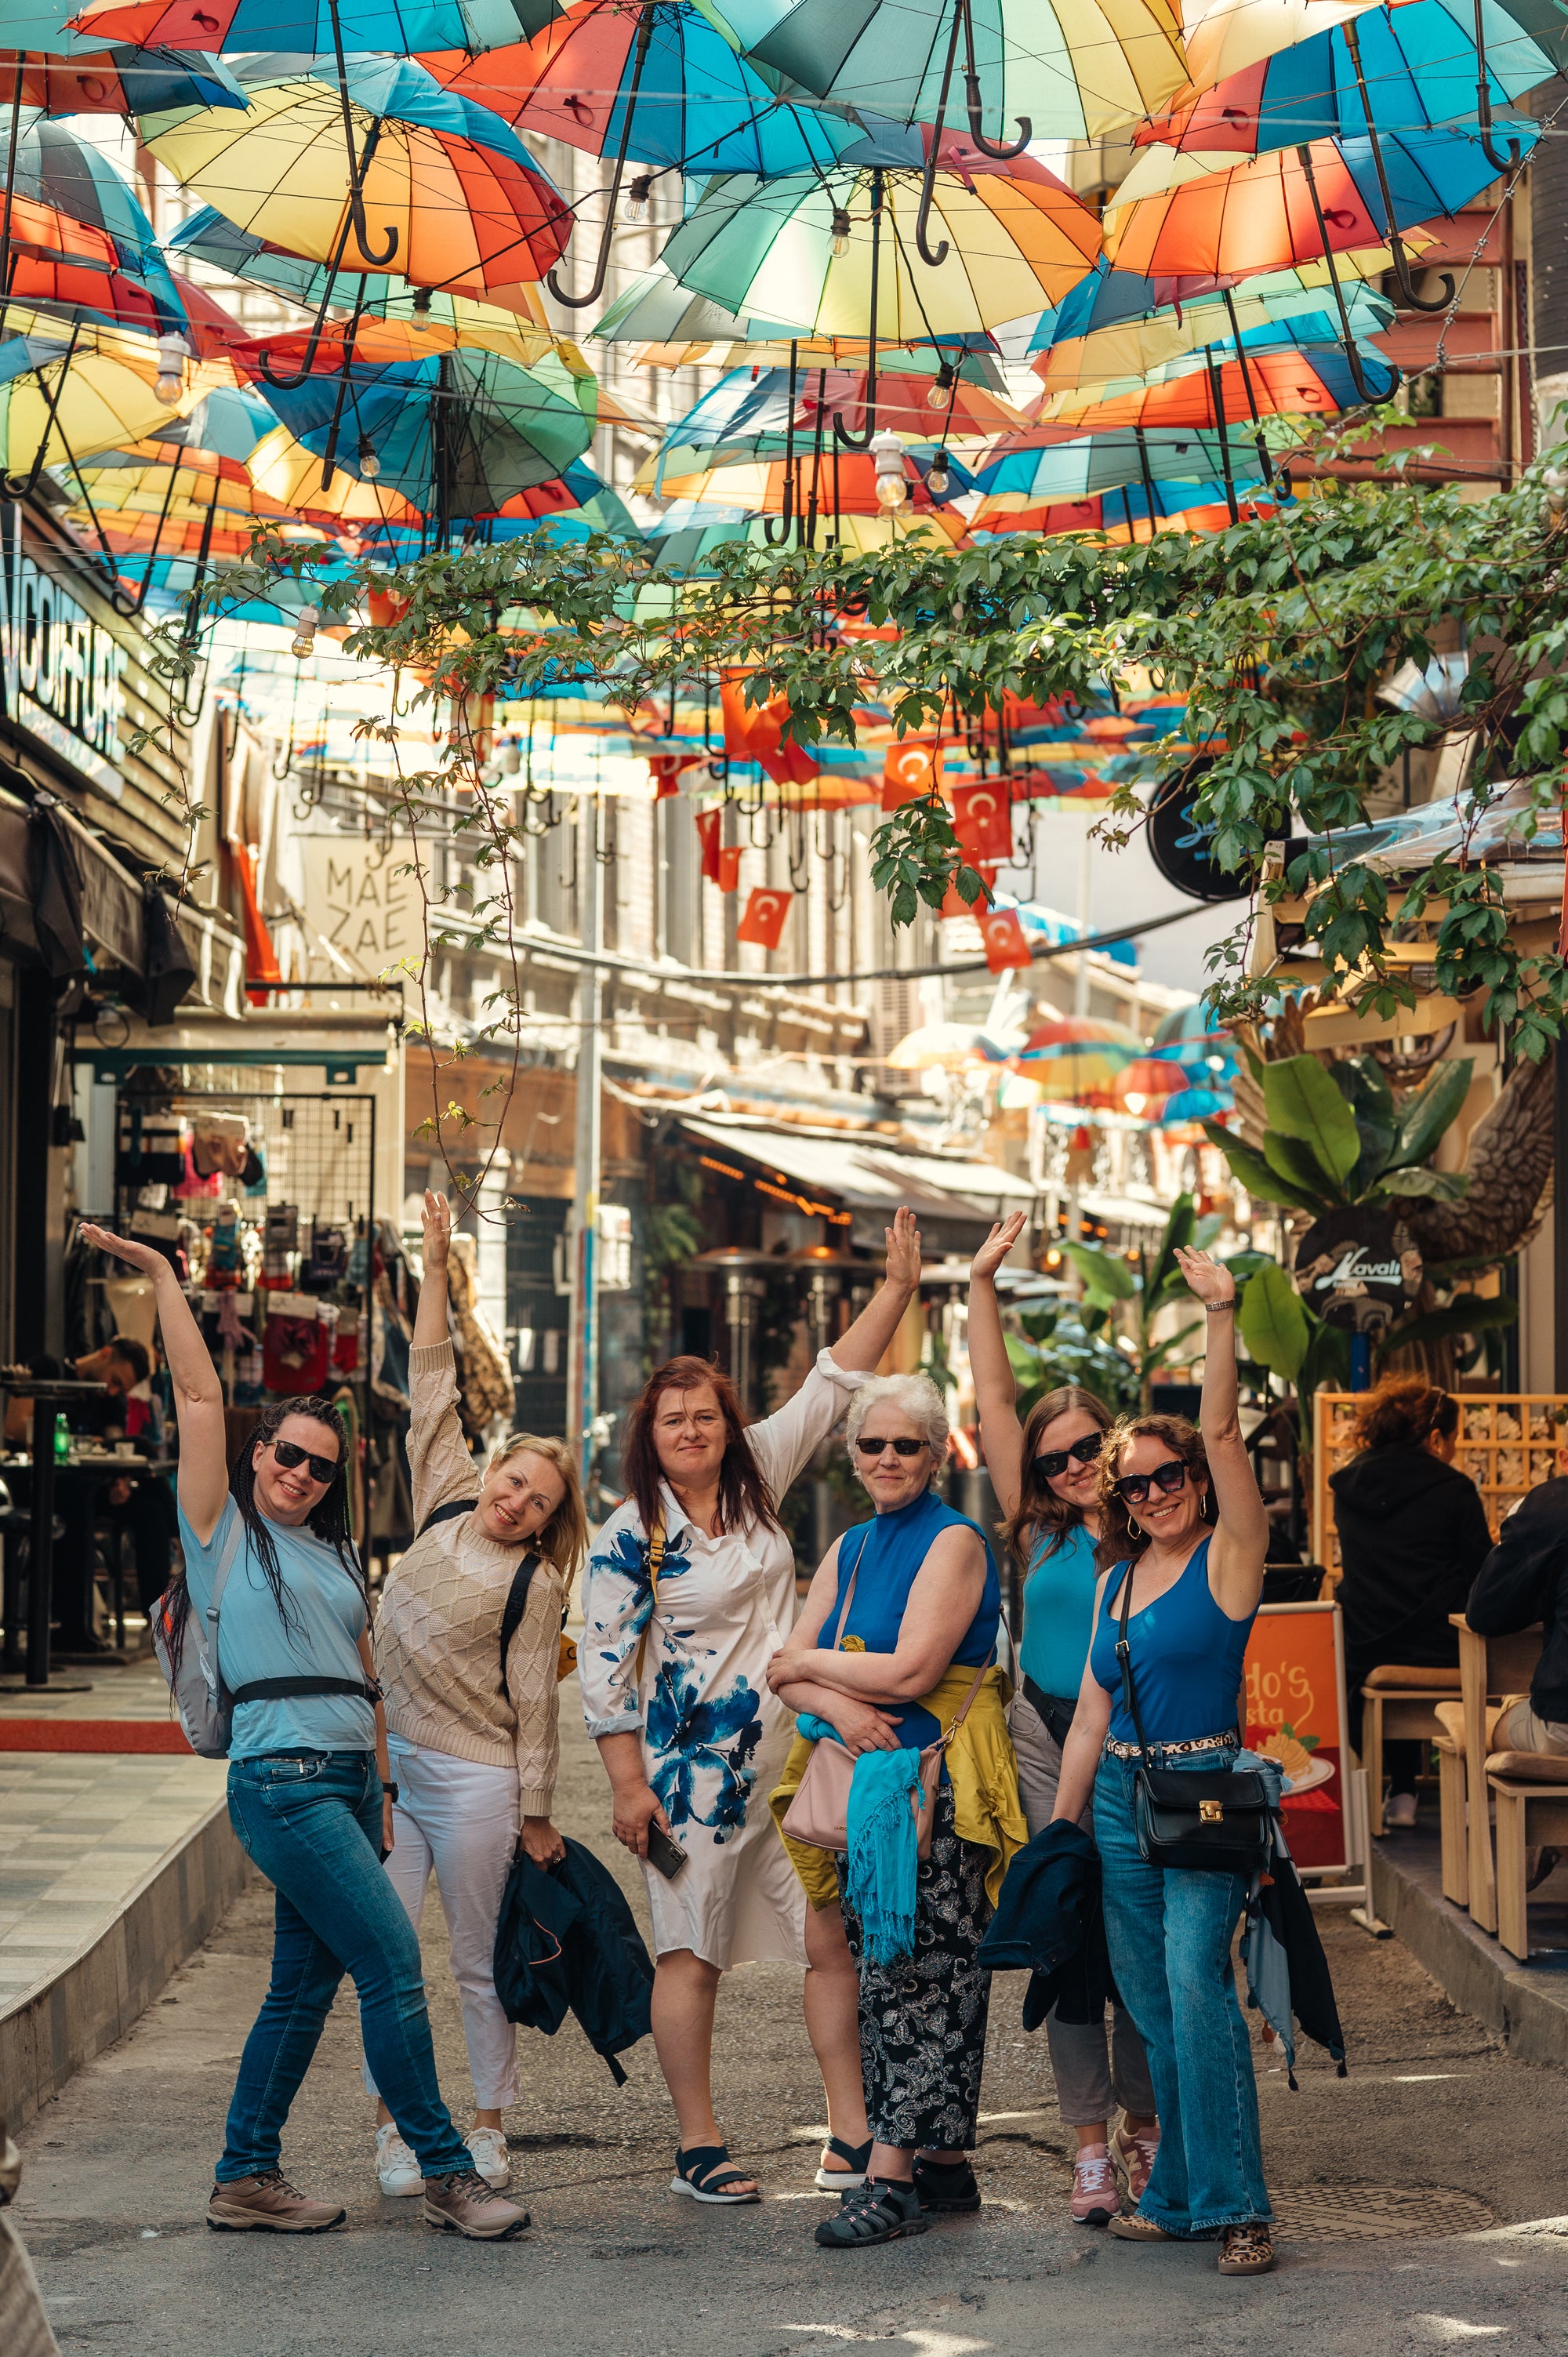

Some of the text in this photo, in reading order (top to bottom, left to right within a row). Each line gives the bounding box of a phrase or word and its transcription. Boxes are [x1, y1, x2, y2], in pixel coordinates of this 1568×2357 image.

[326, 856, 409, 909] MAE
[326, 903, 408, 954] ZAE
[1246, 1662, 1313, 1704] do's
[1246, 1700, 1284, 1727] sta
